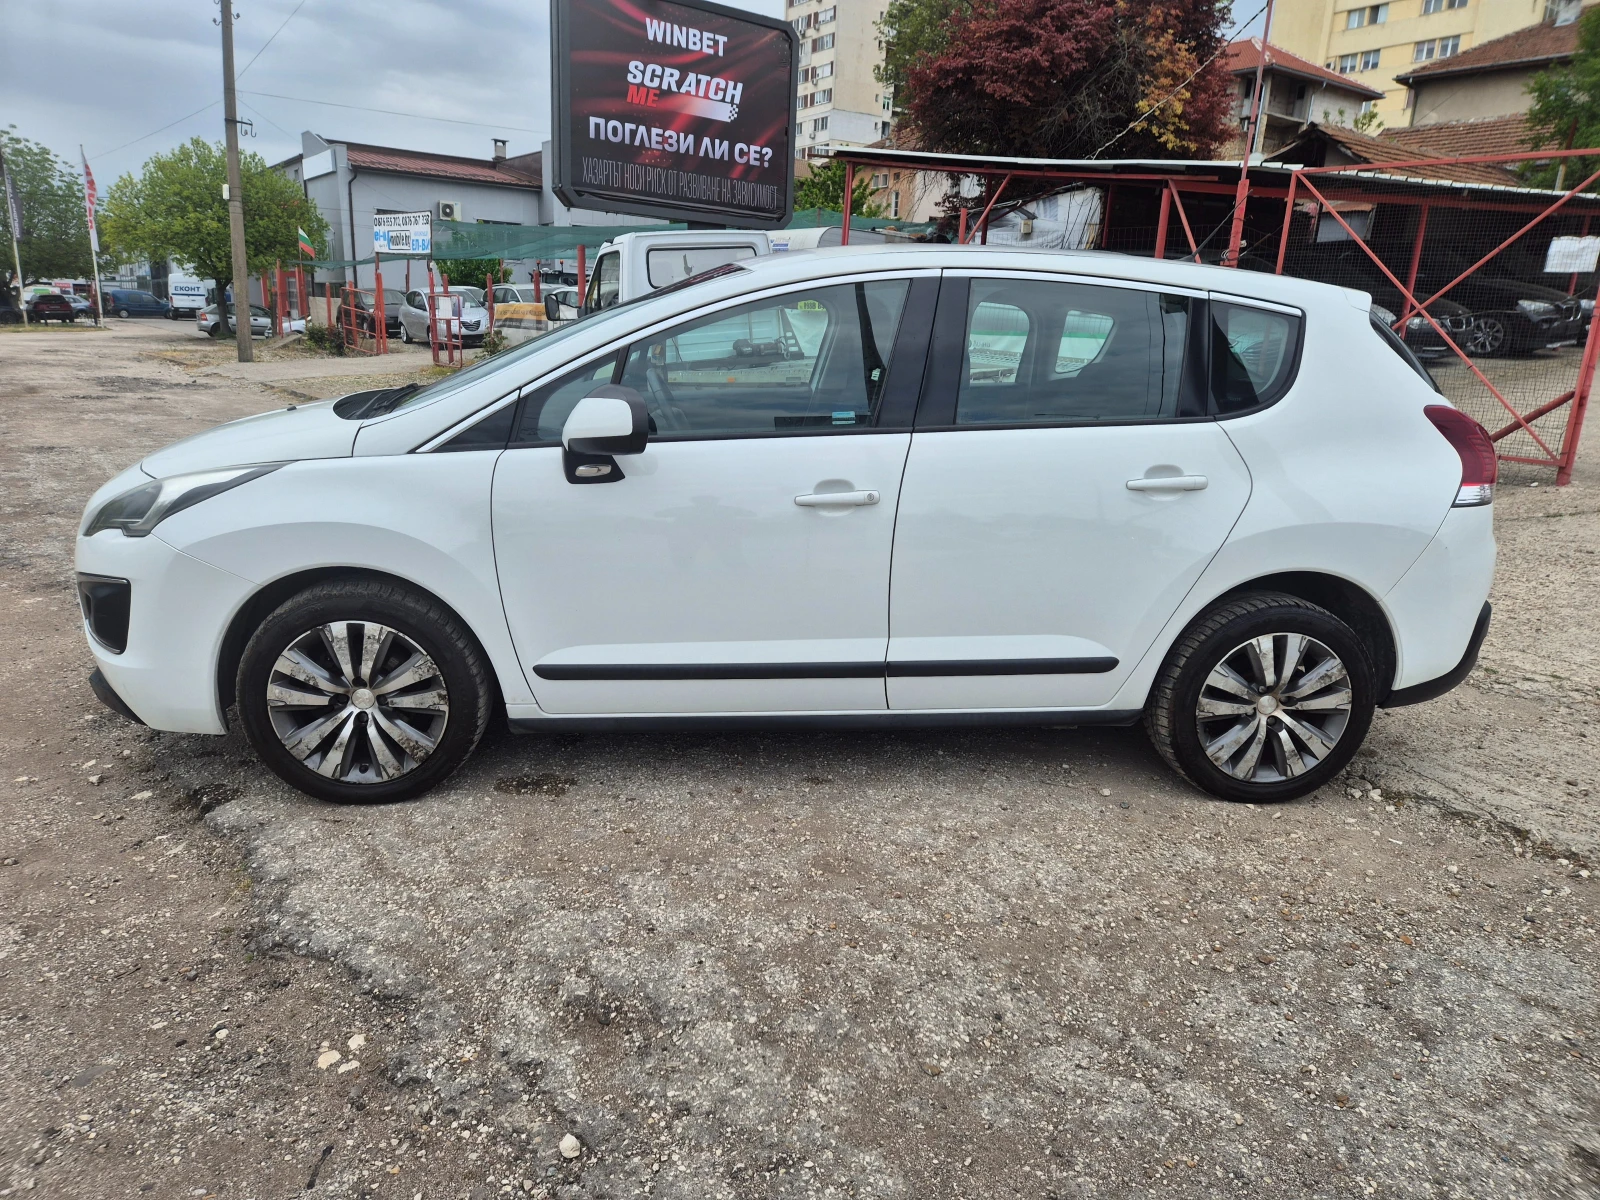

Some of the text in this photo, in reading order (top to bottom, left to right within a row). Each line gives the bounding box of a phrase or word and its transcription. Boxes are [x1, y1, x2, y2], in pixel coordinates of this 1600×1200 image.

[645, 17, 728, 57] WINBET
[627, 60, 743, 105] SCRATCH
[627, 84, 660, 108] ME
[589, 116, 773, 168] ПОГЛЕЗИ ЛИ СЕ?
[582, 156, 778, 209] ХАЗАРТЪТ НОСИ РИСК ОТ РАЗВИВАНЕ НА ЗАВИСИМОСТ
